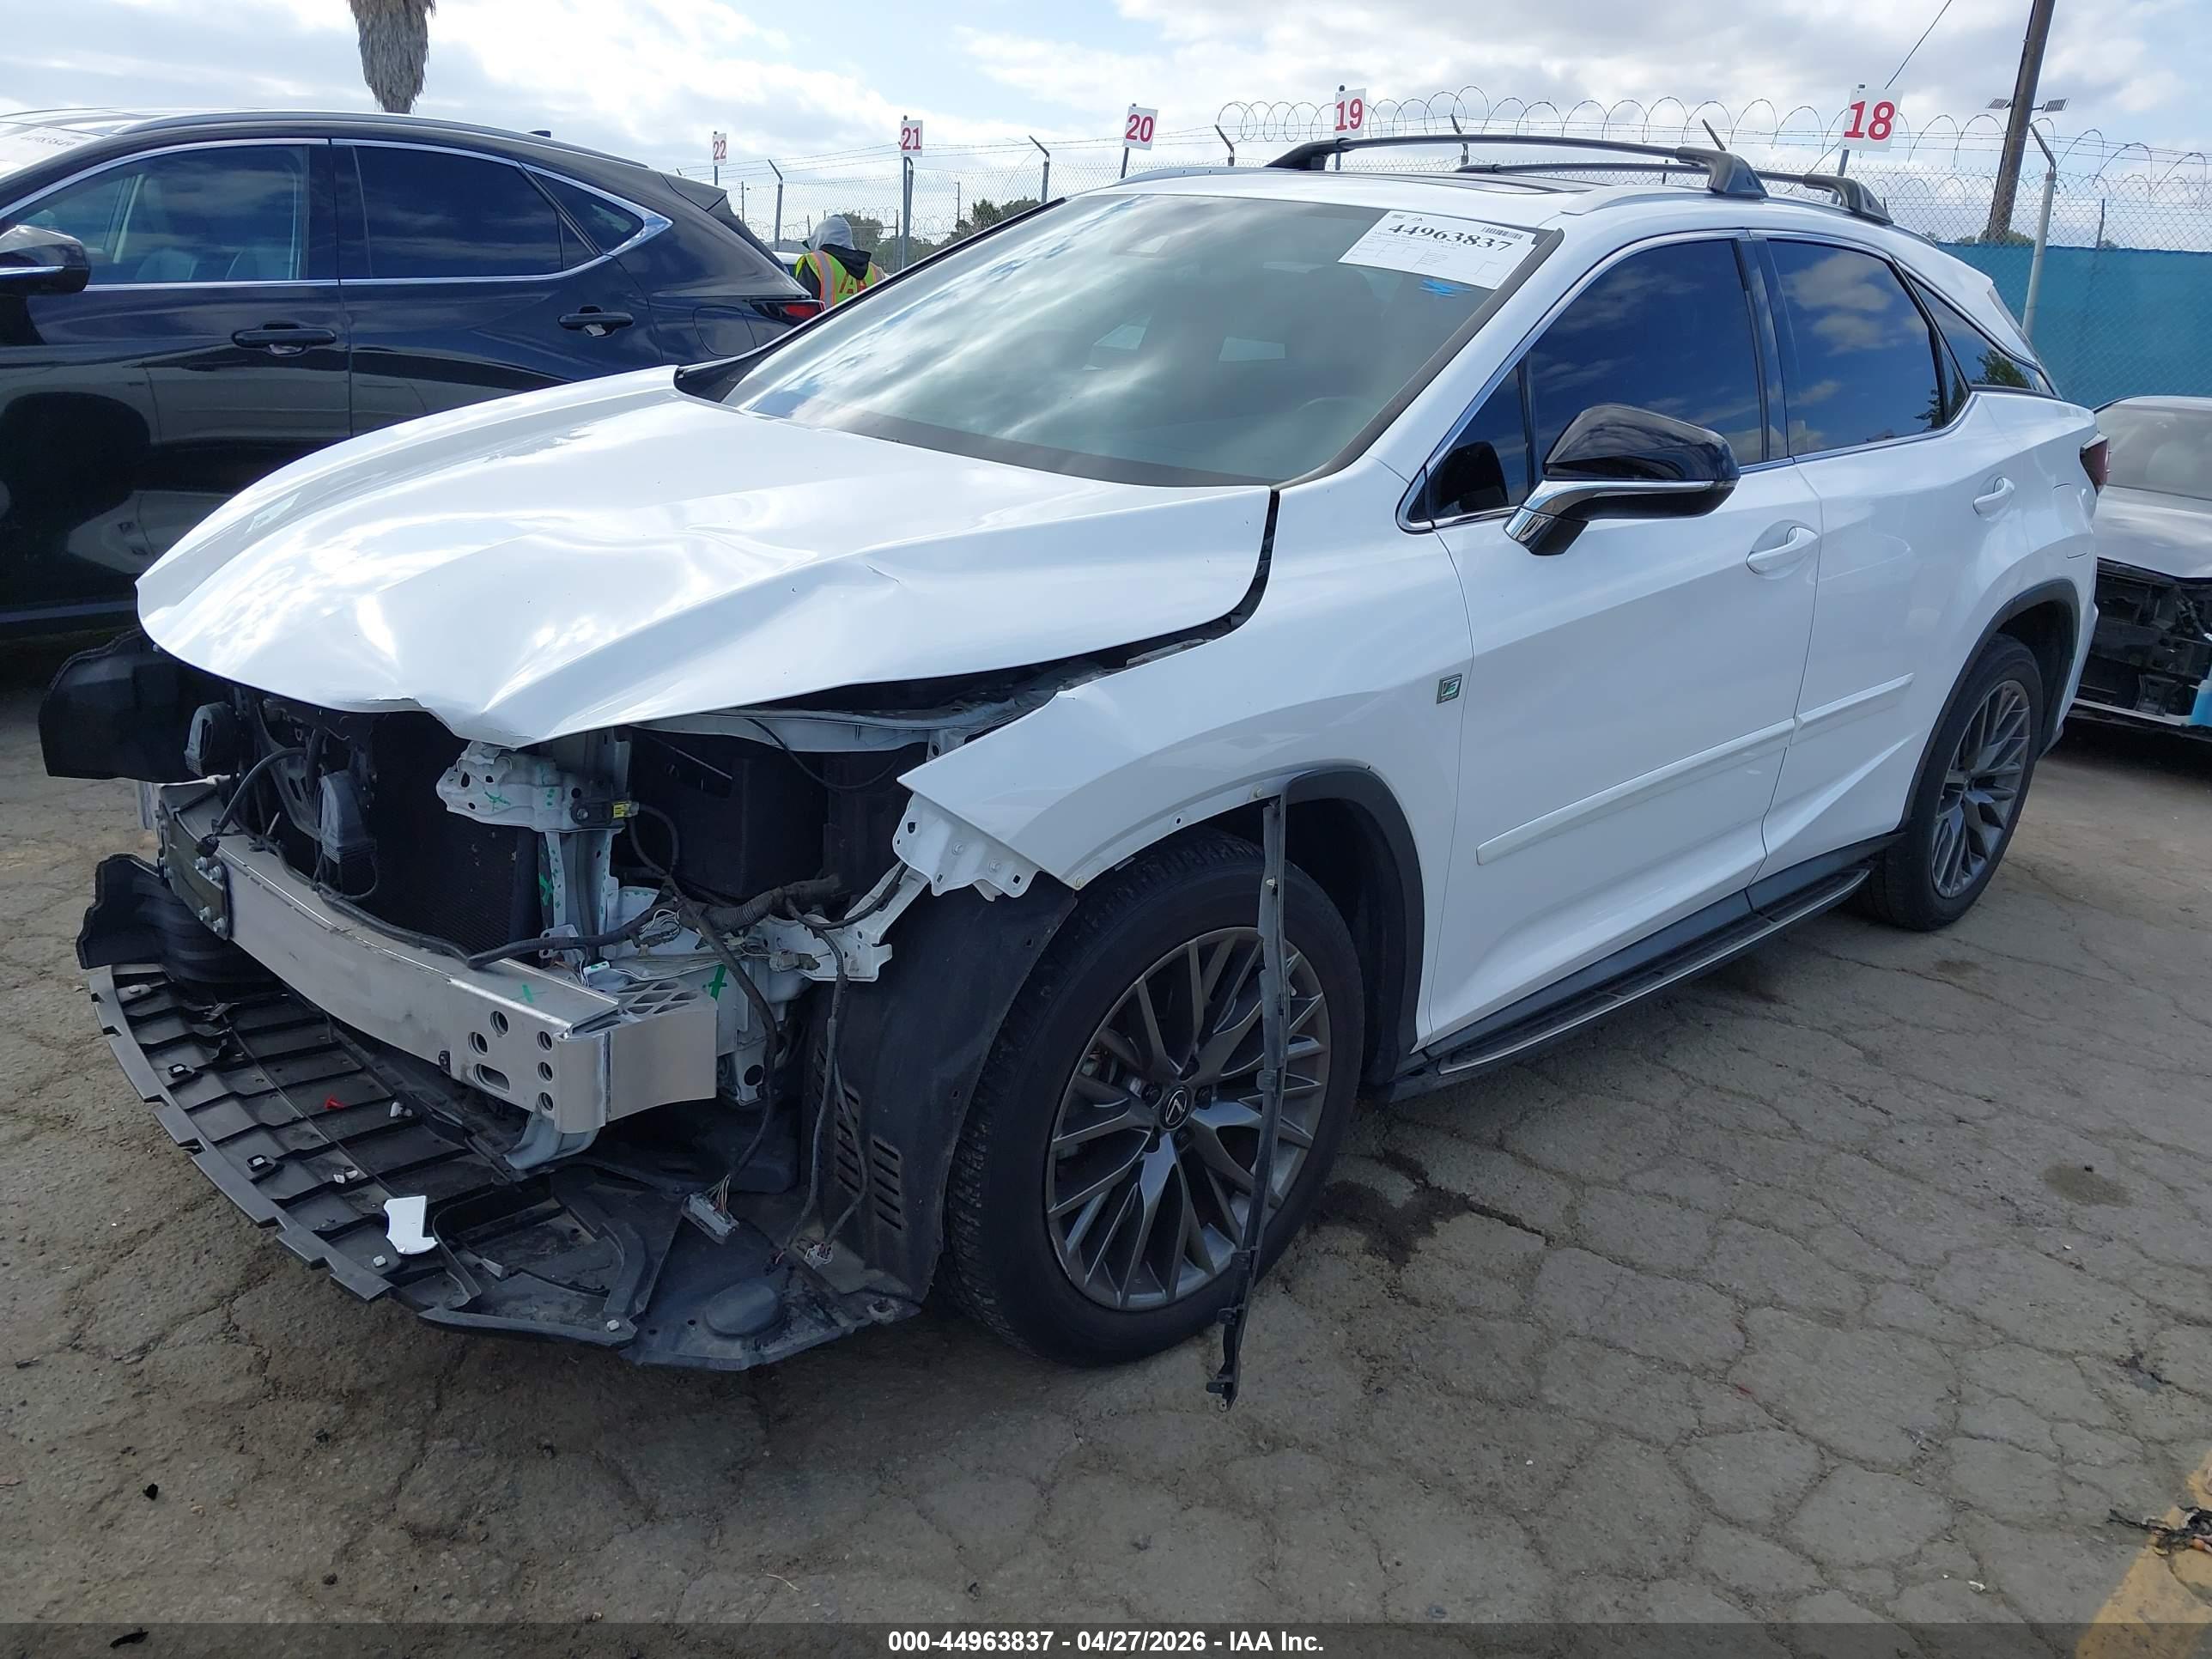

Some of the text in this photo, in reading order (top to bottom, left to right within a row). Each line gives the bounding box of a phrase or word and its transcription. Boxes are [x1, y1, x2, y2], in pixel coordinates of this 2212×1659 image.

[1126, 113, 1154, 143] 20
[1335, 98, 1363, 131] 19
[1844, 100, 1895, 141] 18
[713, 139, 726, 161] 22
[902, 126, 921, 150] 21
[1388, 223, 1514, 252] 44963837
